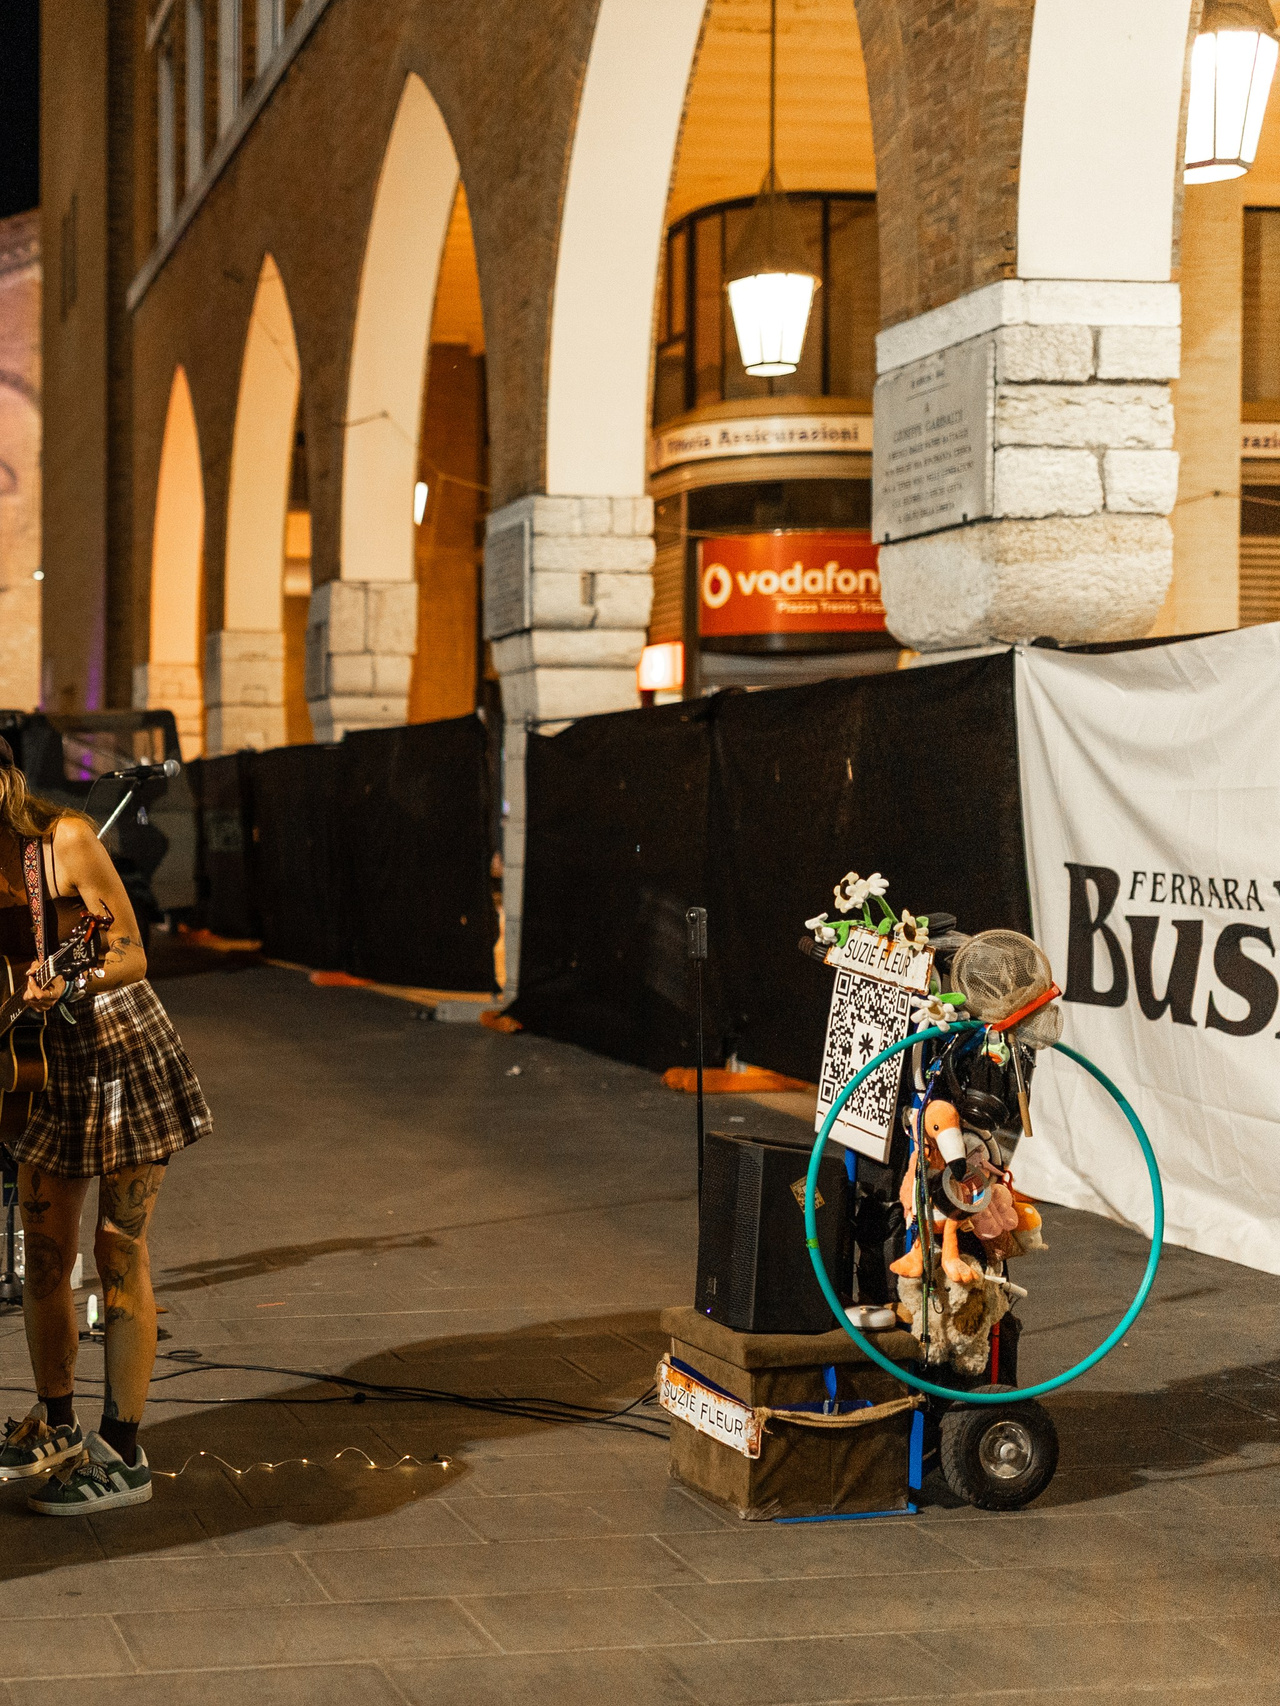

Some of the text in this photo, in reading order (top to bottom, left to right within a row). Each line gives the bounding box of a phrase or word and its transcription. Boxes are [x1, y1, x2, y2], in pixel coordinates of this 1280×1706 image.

[735, 560, 881, 596] vodafon
[1128, 871, 1265, 912] FERRARA
[844, 939, 912, 978] SUZIE FLEUR
[663, 1379, 744, 1438] SUZIE FLEUR
